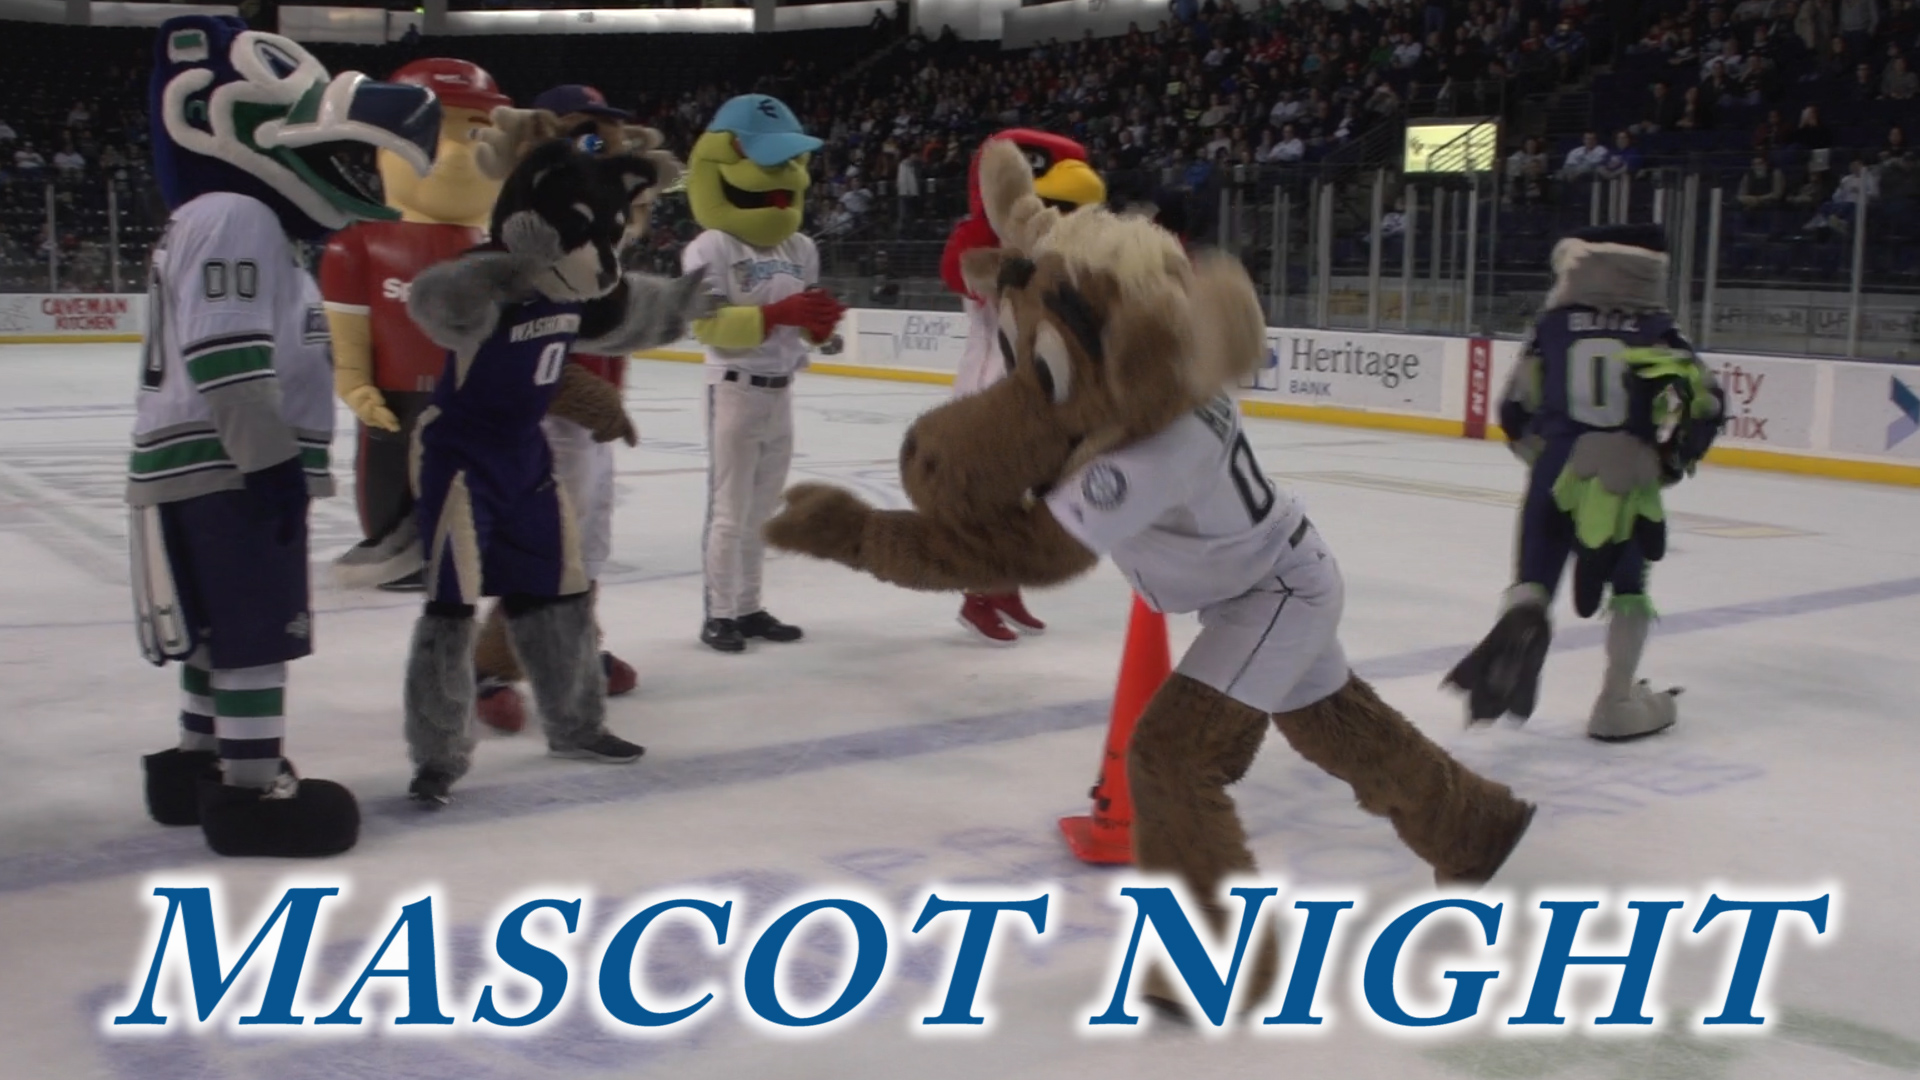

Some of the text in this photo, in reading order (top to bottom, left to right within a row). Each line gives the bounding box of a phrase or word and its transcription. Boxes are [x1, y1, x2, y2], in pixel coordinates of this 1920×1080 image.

[42, 297, 128, 315] CAVEMAN
[55, 316, 116, 330] KITCHEN
[533, 341, 567, 386] 0
[1290, 337, 1420, 388] Heritage
[1290, 379, 1331, 396] BANK
